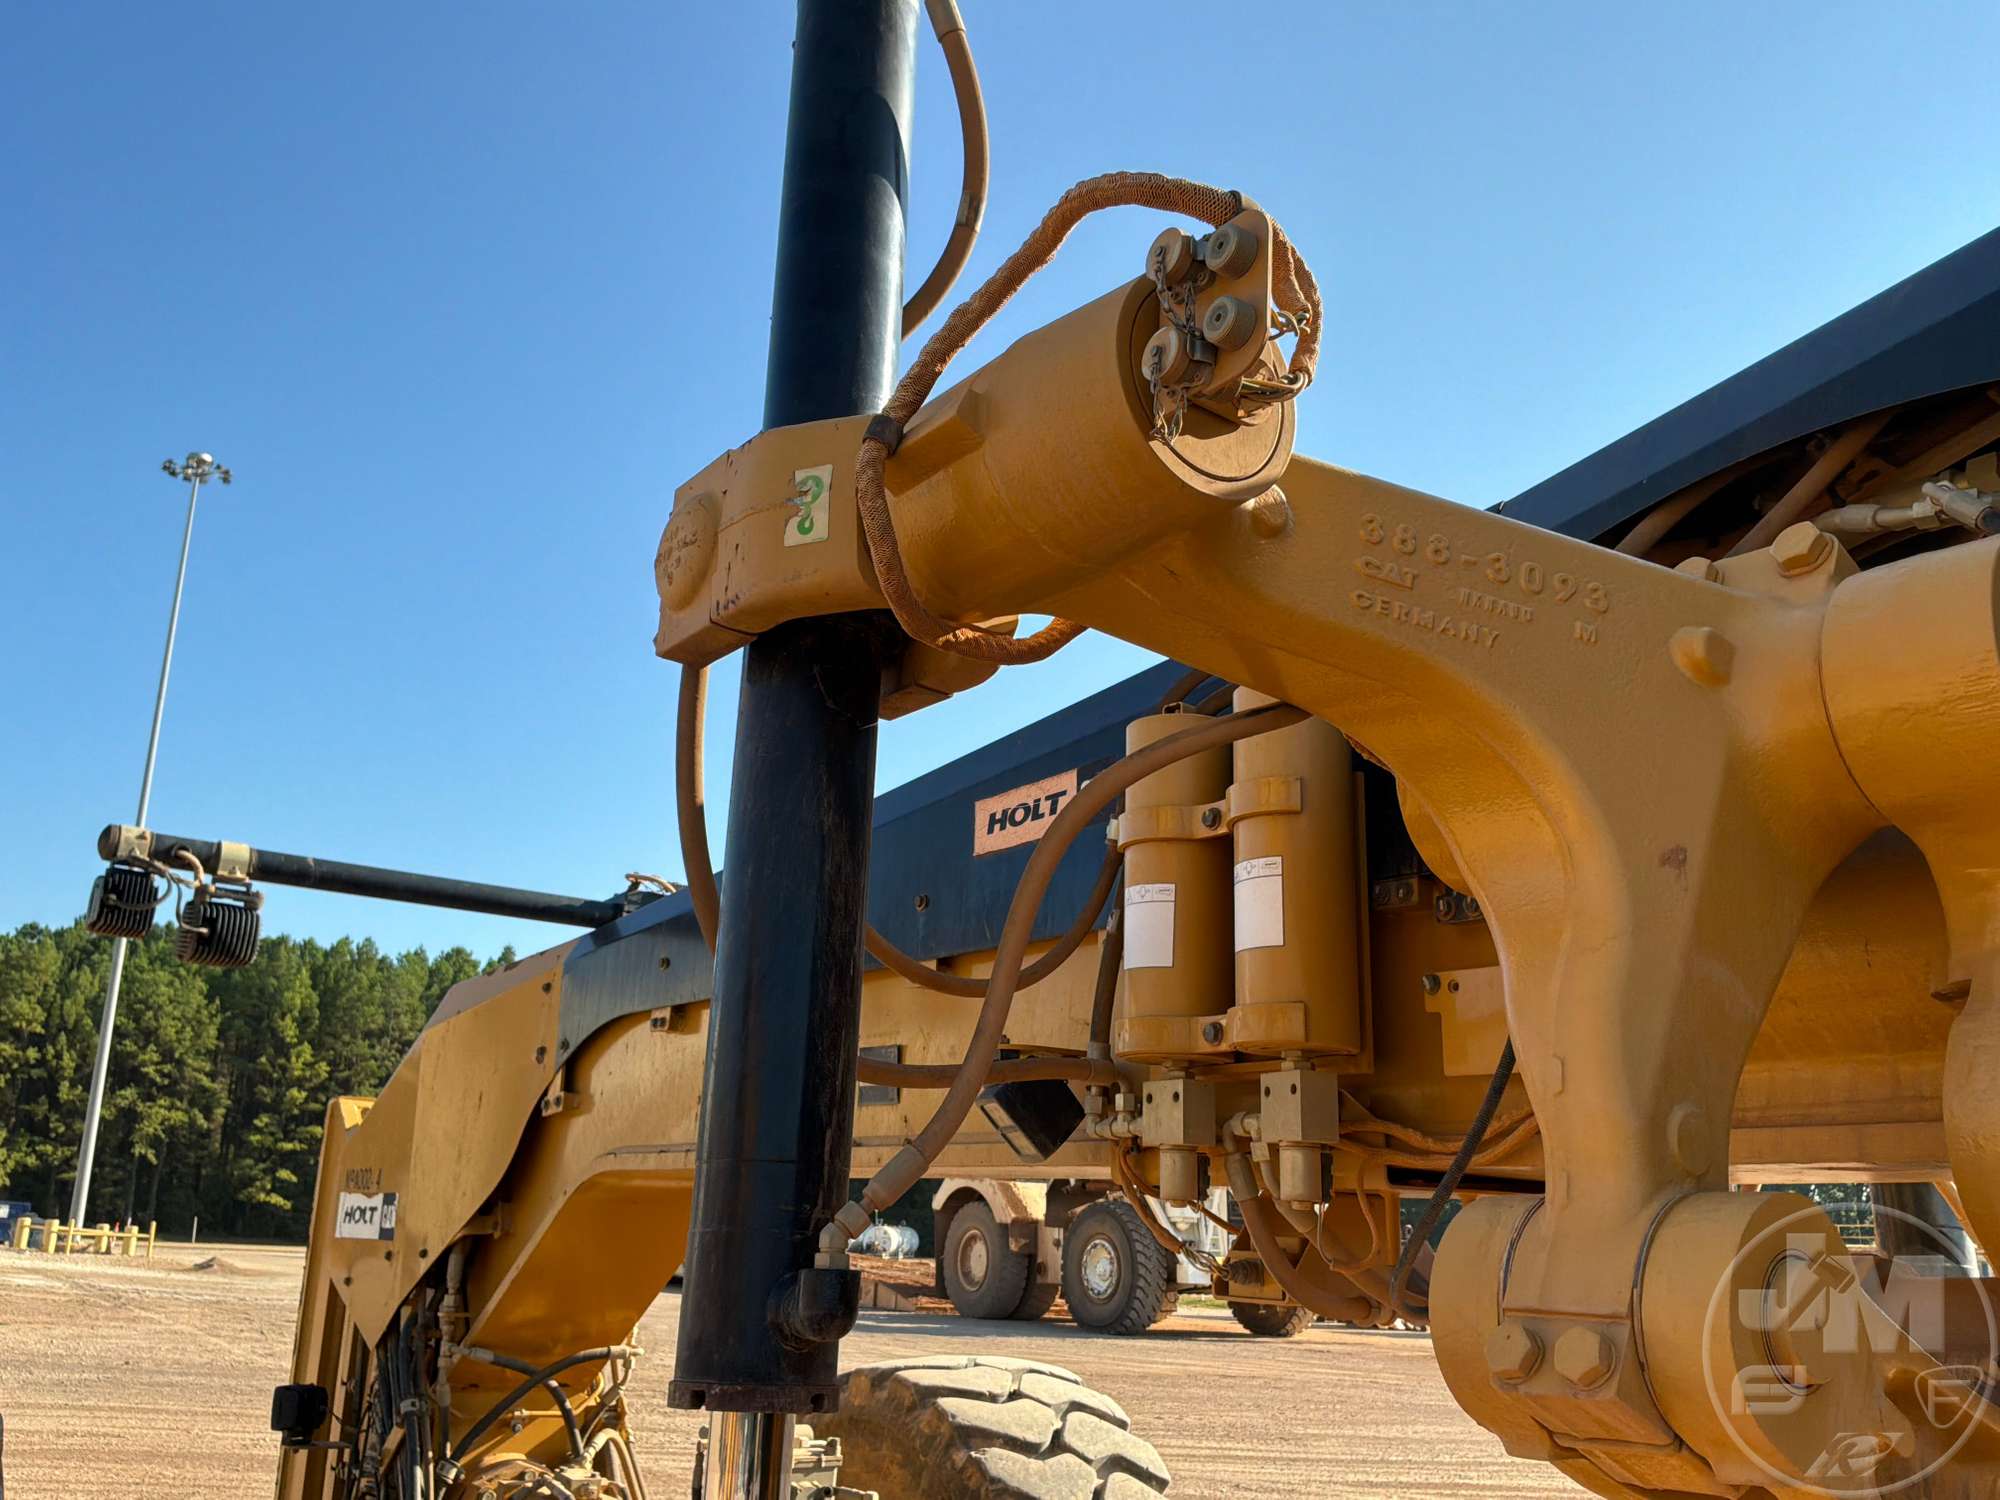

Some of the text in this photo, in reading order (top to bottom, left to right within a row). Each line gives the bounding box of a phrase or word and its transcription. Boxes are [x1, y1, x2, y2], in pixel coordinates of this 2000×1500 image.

[1358, 555, 1419, 591] CAT
[1354, 590, 1500, 650] GERMANY
[986, 789, 1068, 836] HOLT
[343, 1205, 378, 1225] HOLT
